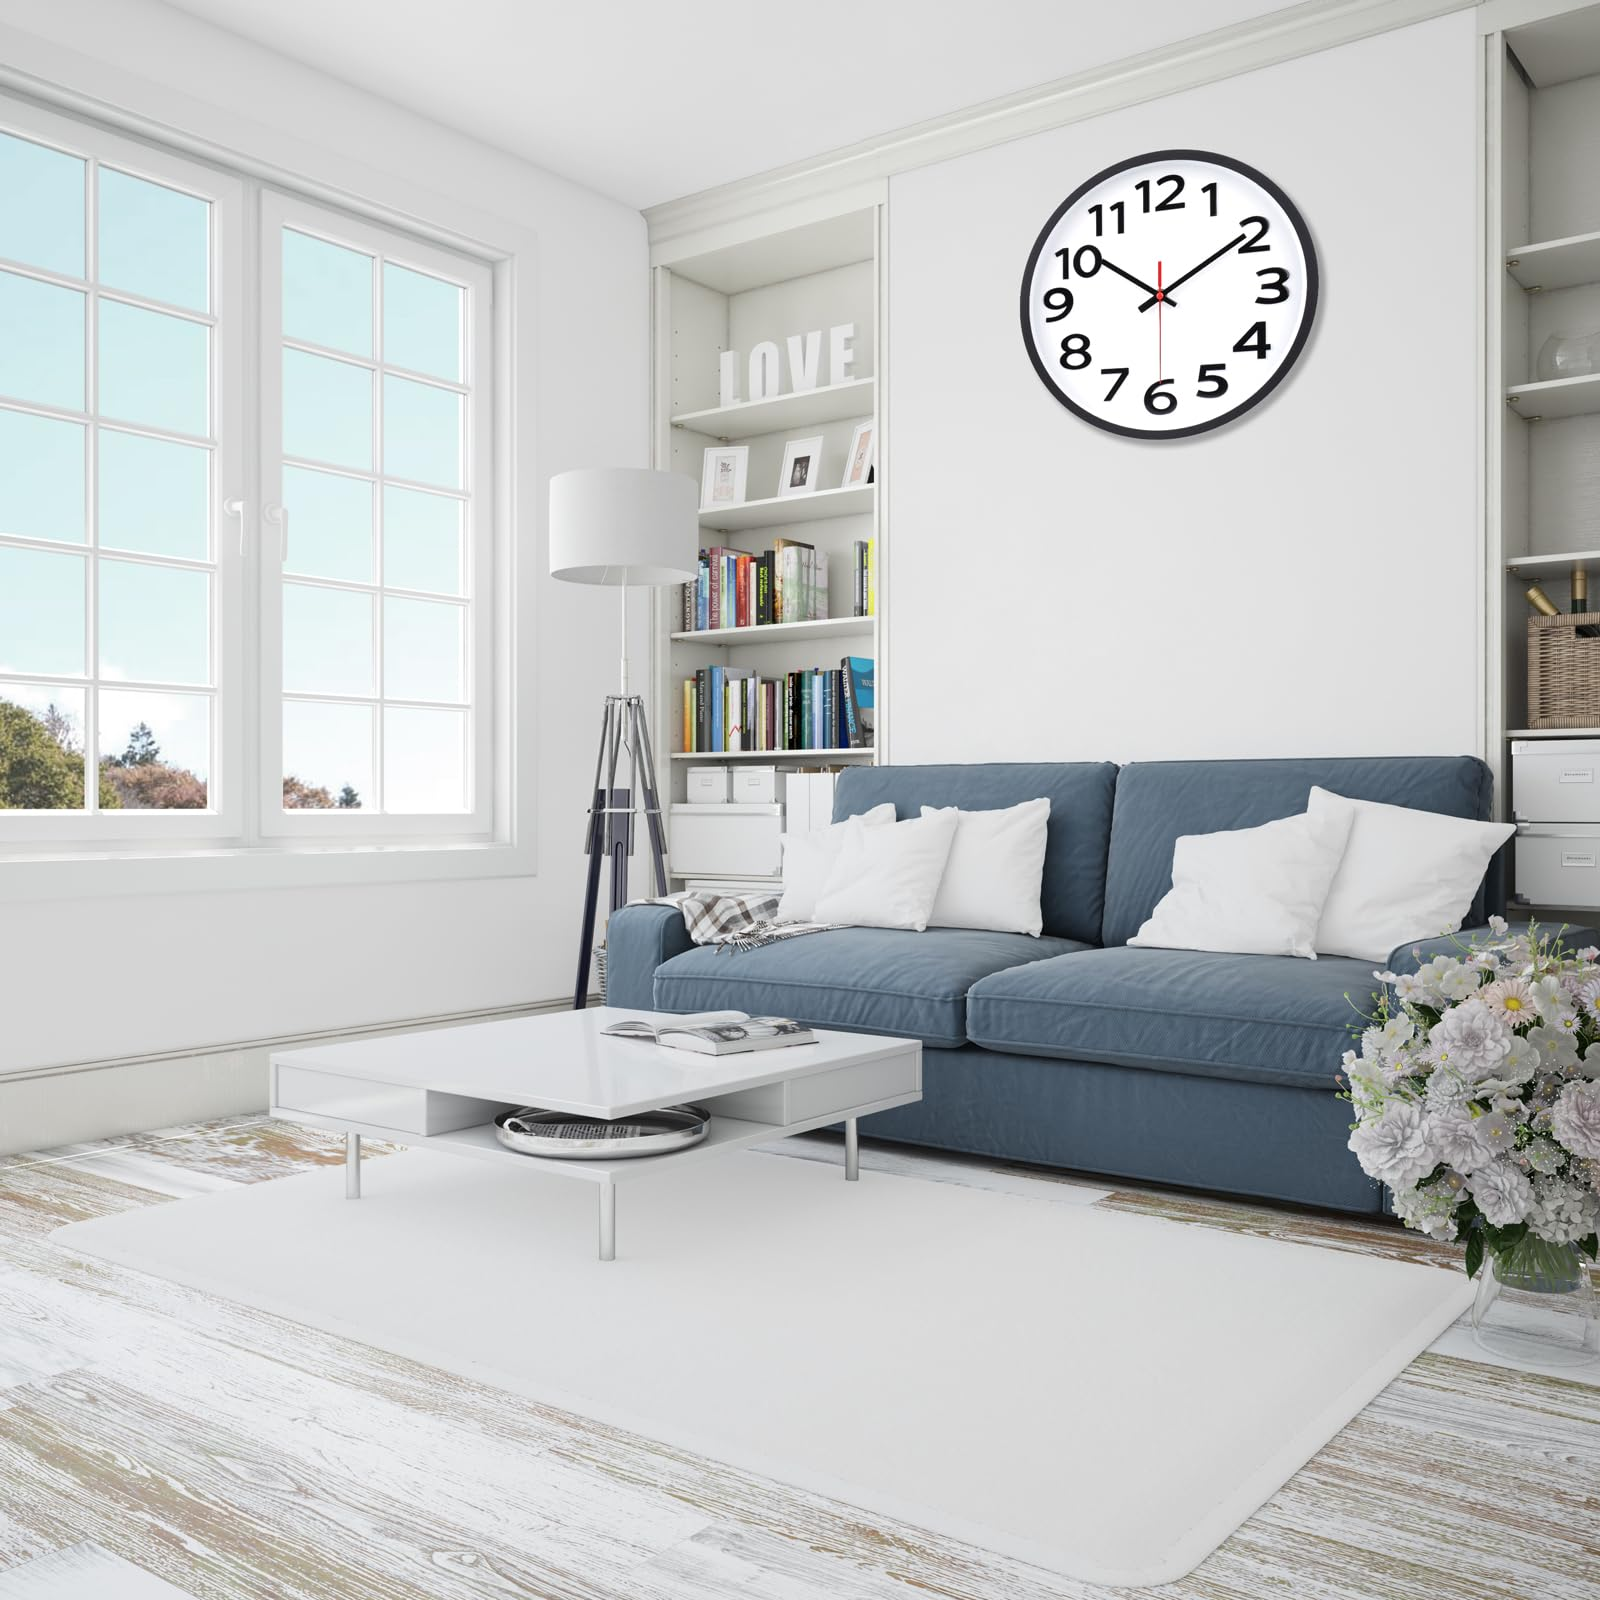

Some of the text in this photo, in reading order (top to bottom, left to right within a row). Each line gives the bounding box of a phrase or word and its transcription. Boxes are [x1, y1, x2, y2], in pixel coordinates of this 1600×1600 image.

[1134, 174, 1185, 214] 12
[1201, 182, 1218, 217] 1
[1088, 201, 1125, 237] 11
[1237, 215, 1271, 254] 2
[1055, 244, 1103, 280] 10
[1255, 267, 1290, 305] 3
[1043, 287, 1074, 323] 9
[1060, 333, 1092, 370] 8
[1232, 321, 1271, 359] 4
[720, 323, 855, 408] LOVE
[1196, 363, 1229, 398] 5
[1101, 367, 1130, 402] 7
[1144, 378, 1178, 416] 6
[710, 554, 720, 625] The power of carnival
[841, 665, 850, 698] WALTER
[845, 698, 857, 734] FINANCE
